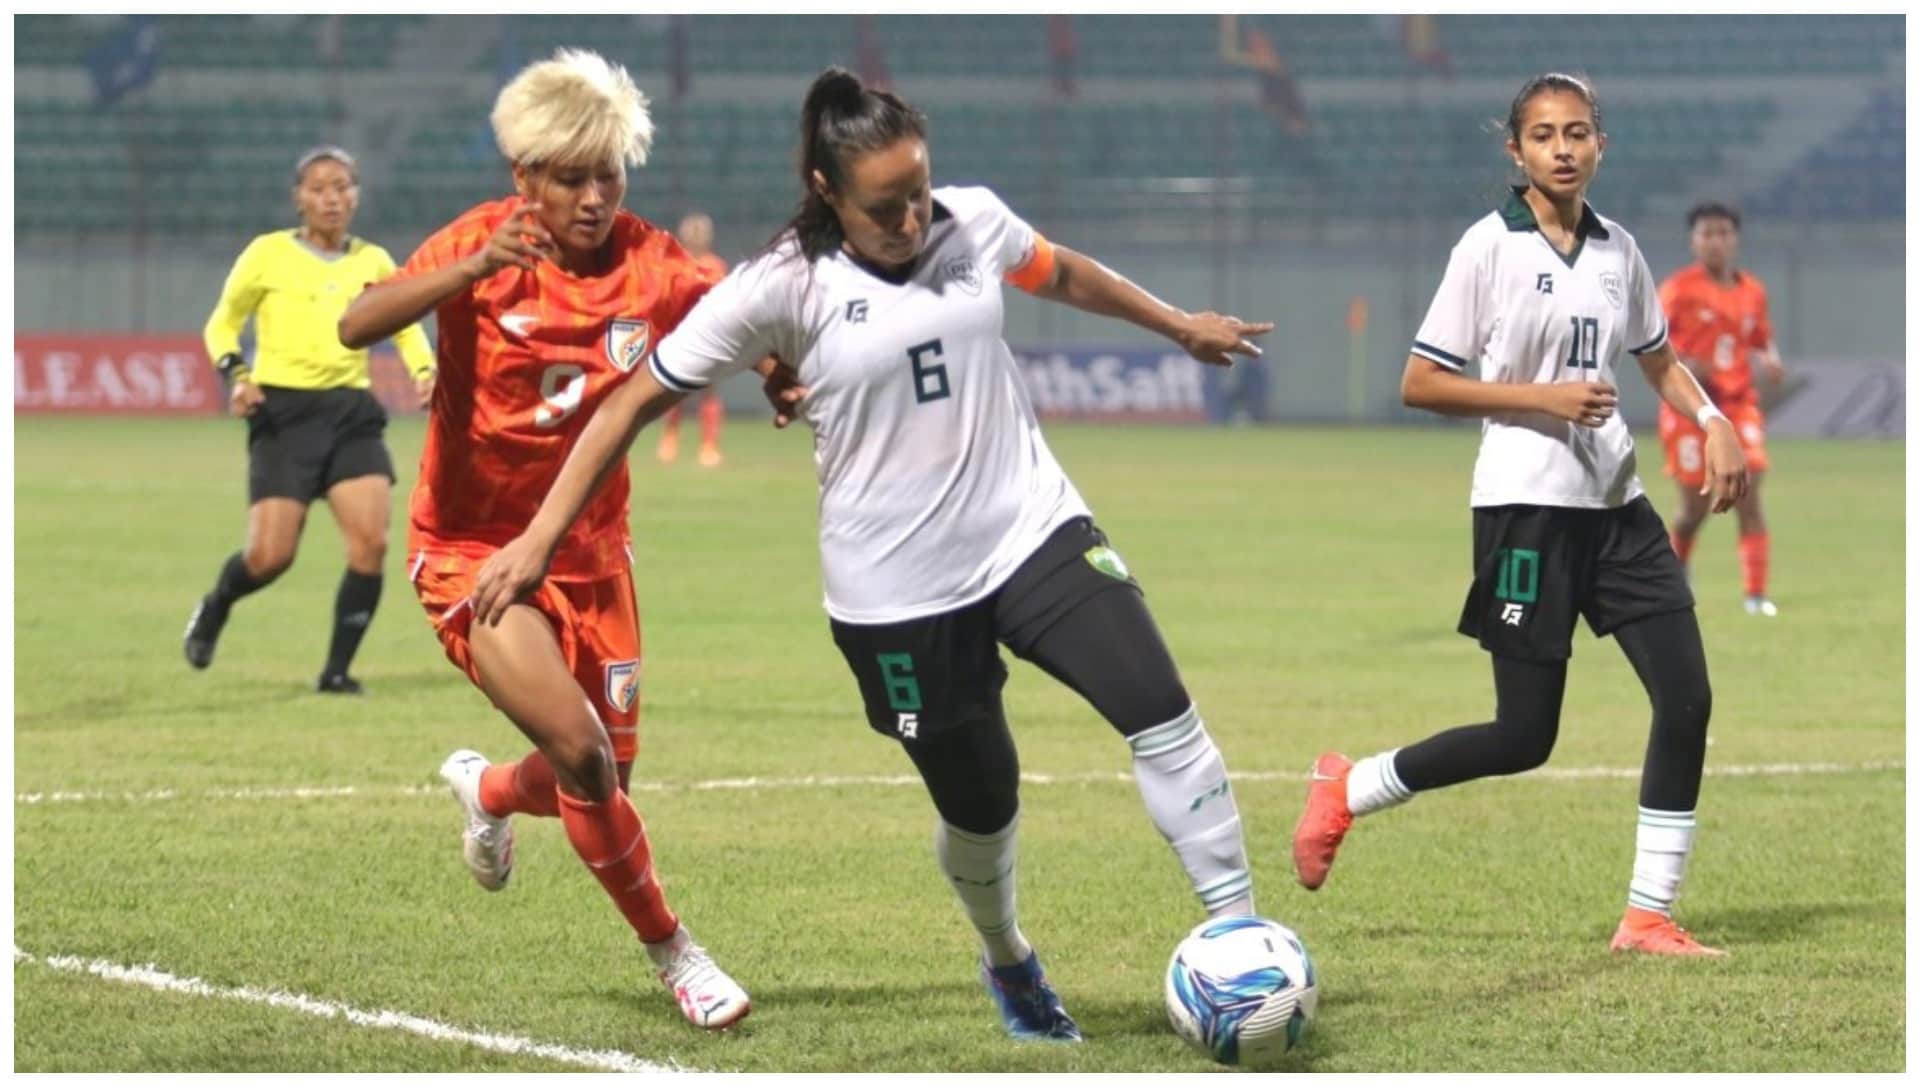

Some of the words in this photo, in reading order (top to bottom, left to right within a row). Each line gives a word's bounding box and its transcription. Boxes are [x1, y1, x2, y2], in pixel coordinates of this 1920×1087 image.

[906, 338, 951, 404] 6
[1566, 315, 1599, 369] 10
[535, 363, 587, 428] 9
[1495, 547, 1539, 603] 10
[876, 652, 923, 711] 6
